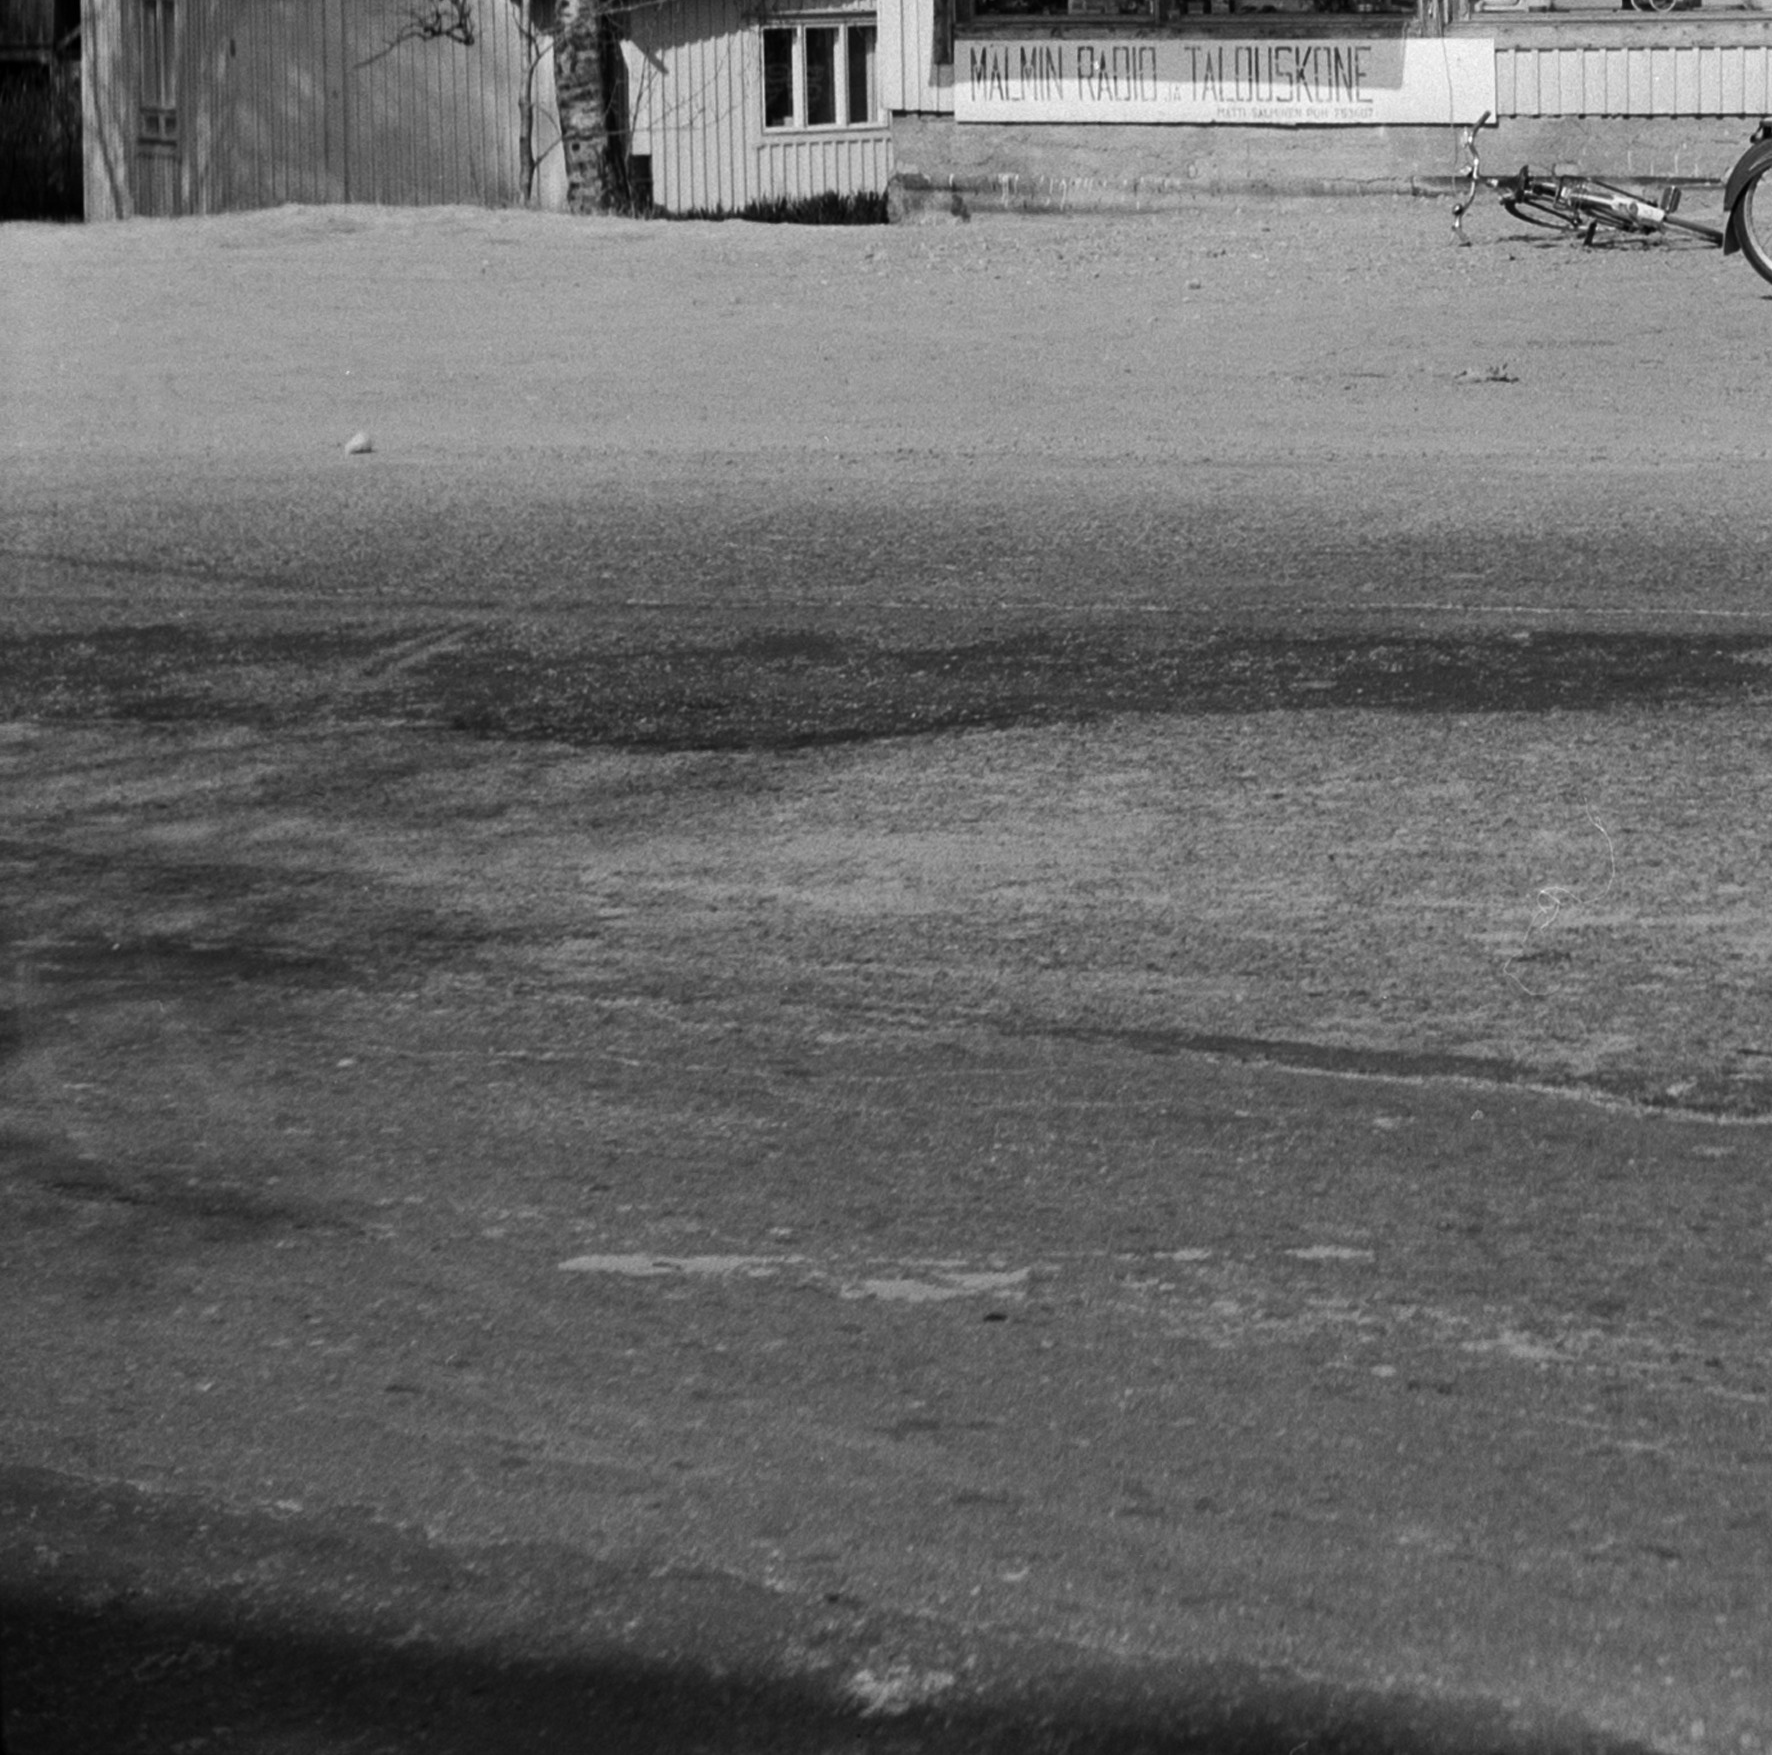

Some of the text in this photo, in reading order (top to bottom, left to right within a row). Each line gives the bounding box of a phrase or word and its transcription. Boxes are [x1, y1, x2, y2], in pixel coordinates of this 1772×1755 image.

[970, 46, 1063, 101] MALMIN
[1077, 47, 1157, 101] RADIO
[1184, 46, 1373, 102] TALOUSKONE
